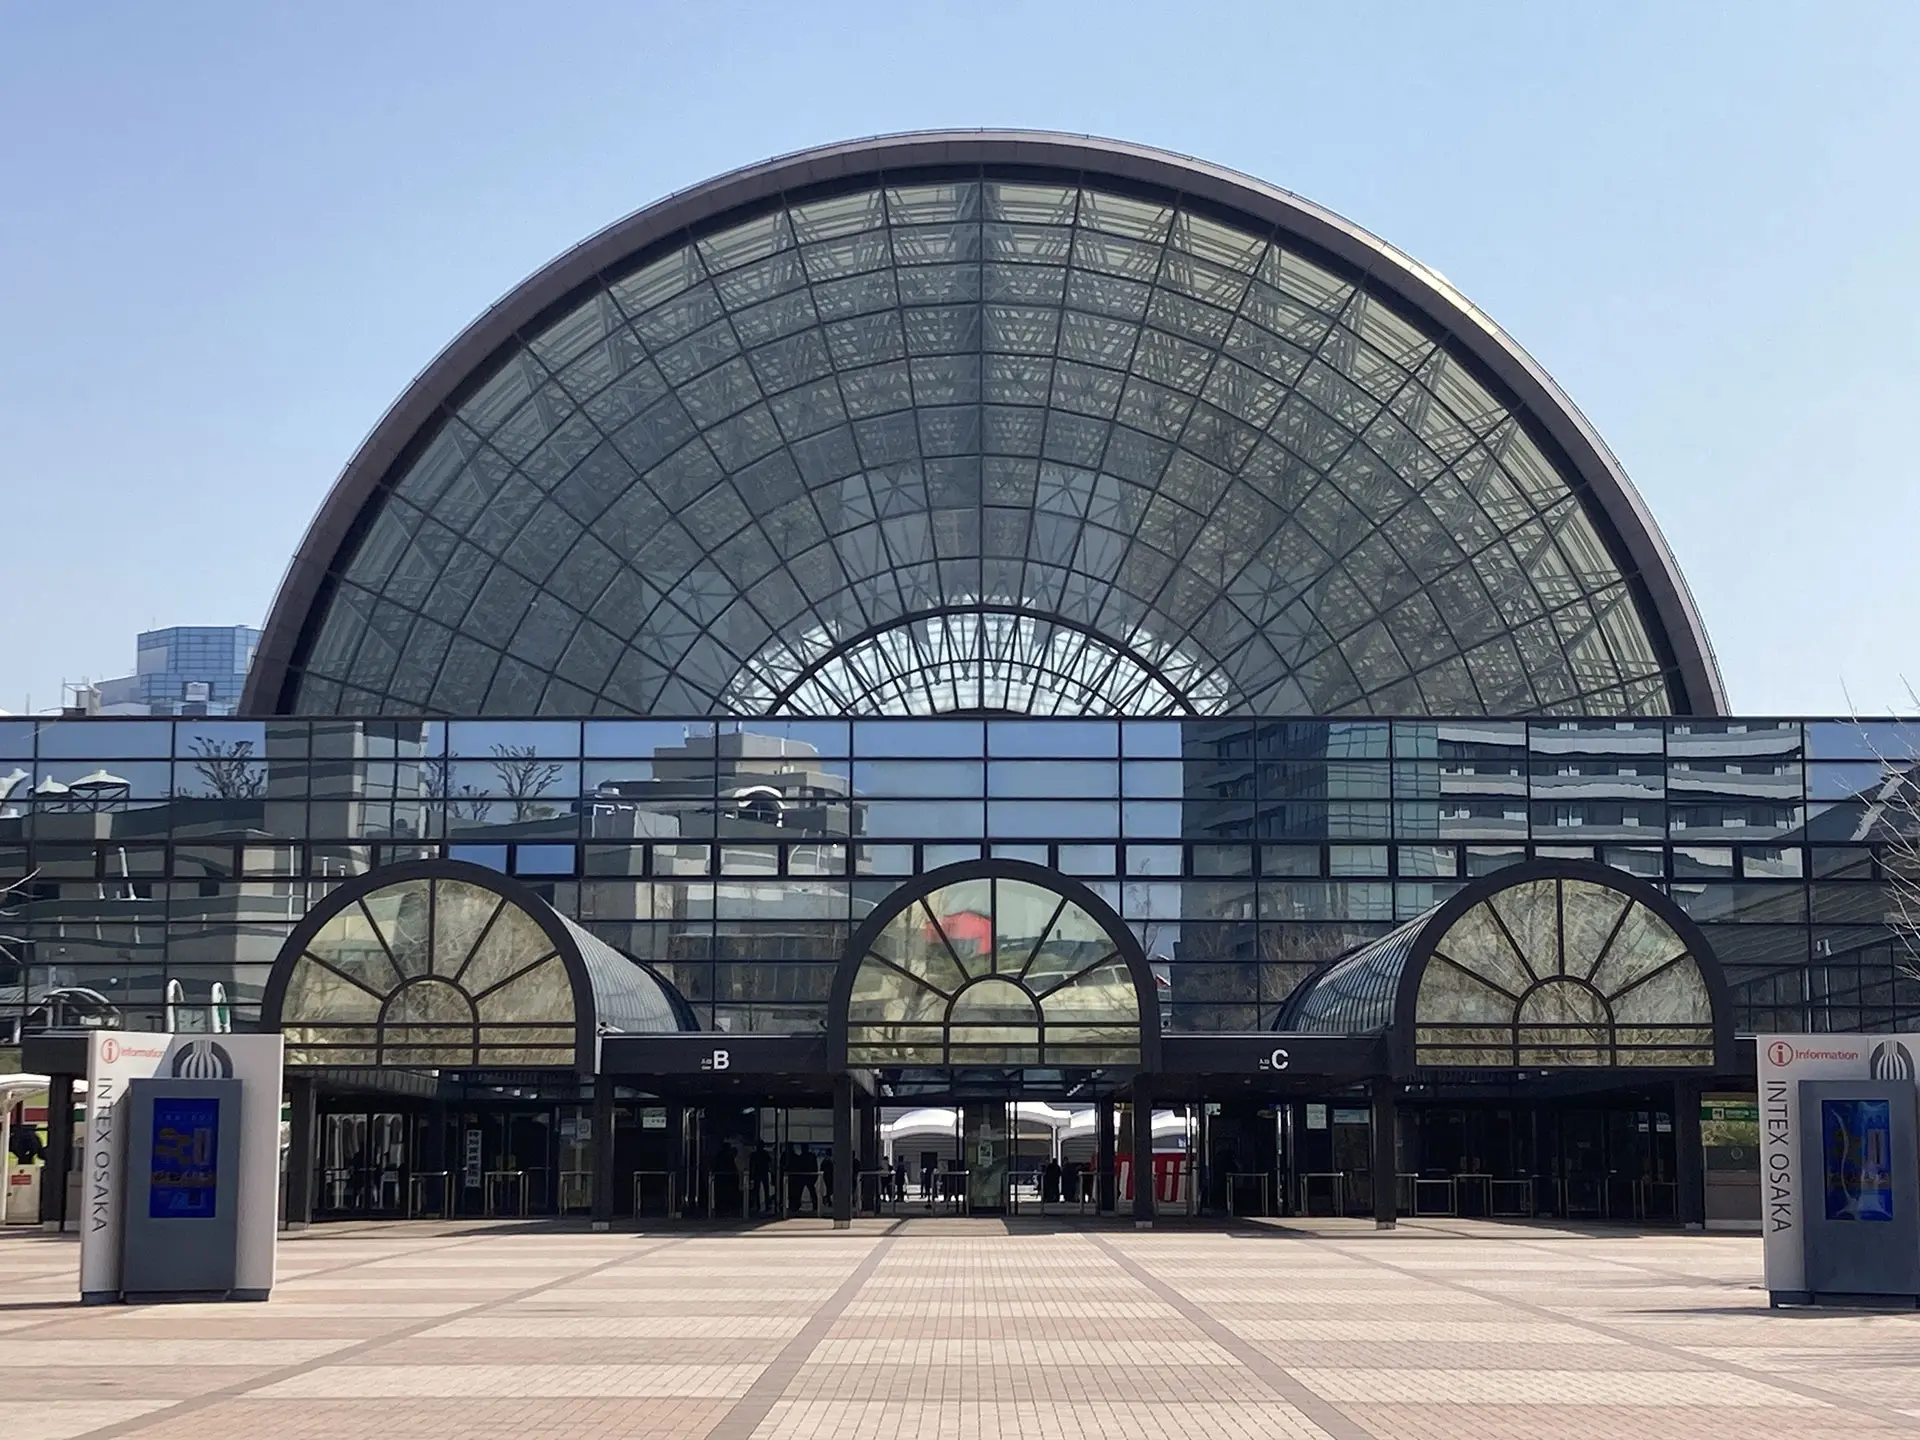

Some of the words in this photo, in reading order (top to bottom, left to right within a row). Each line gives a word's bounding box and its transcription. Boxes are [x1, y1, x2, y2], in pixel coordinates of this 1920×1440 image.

[713, 1050, 730, 1070] B
[1271, 1049, 1289, 1070] C
[1795, 1049, 1859, 1060] Information
[95, 1077, 113, 1144] INTEX
[1766, 1080, 1789, 1146] INTEX
[92, 1152, 110, 1233] OSAKA
[1769, 1153, 1792, 1233] OSAKA
